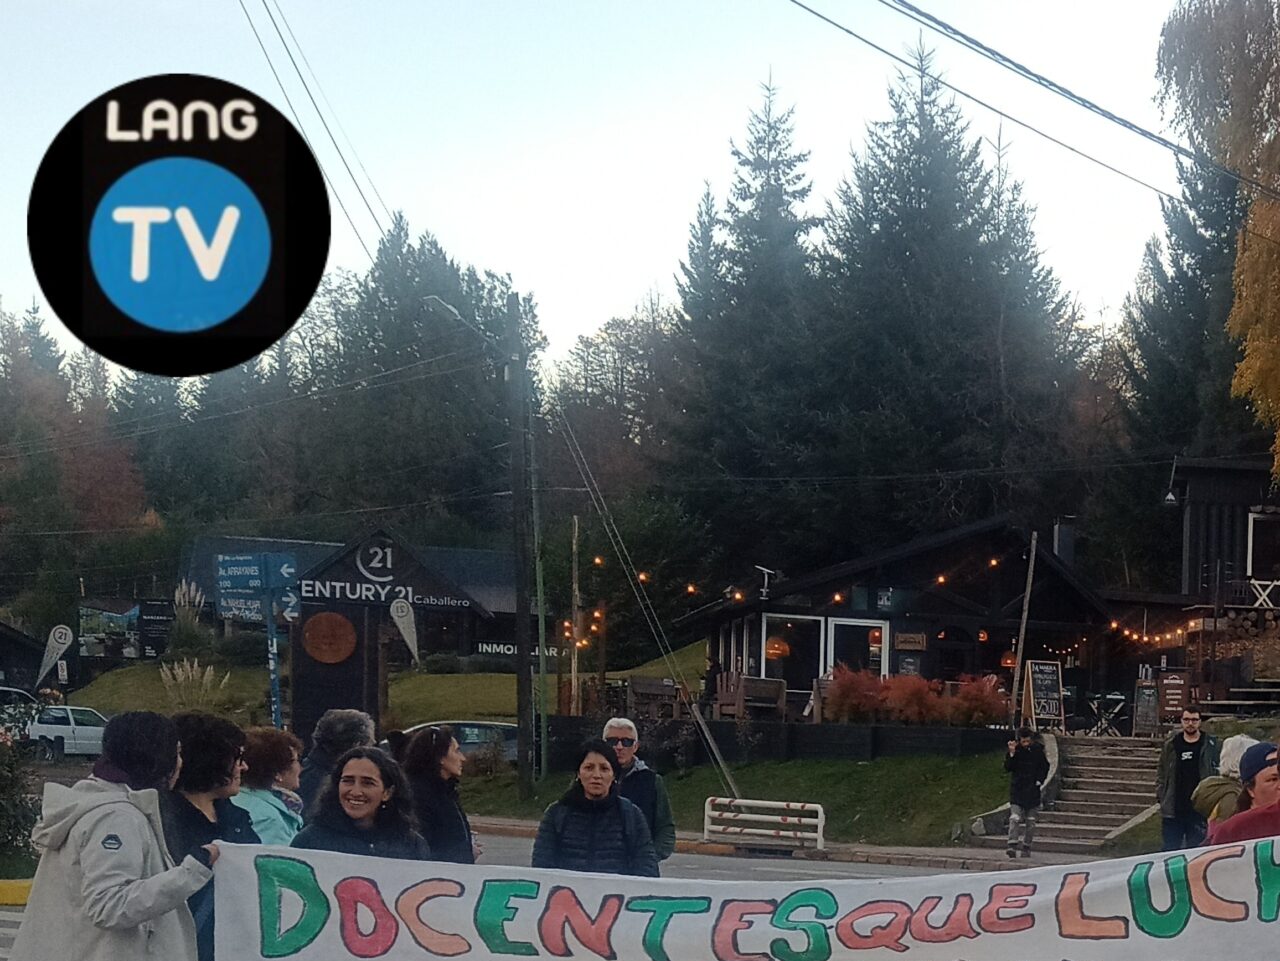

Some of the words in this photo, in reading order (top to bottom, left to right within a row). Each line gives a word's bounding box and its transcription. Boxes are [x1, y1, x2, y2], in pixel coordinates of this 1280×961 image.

[297, 579, 391, 602] ENTURY
[413, 595, 470, 608] Caballero
[834, 883, 1037, 952] QUE
